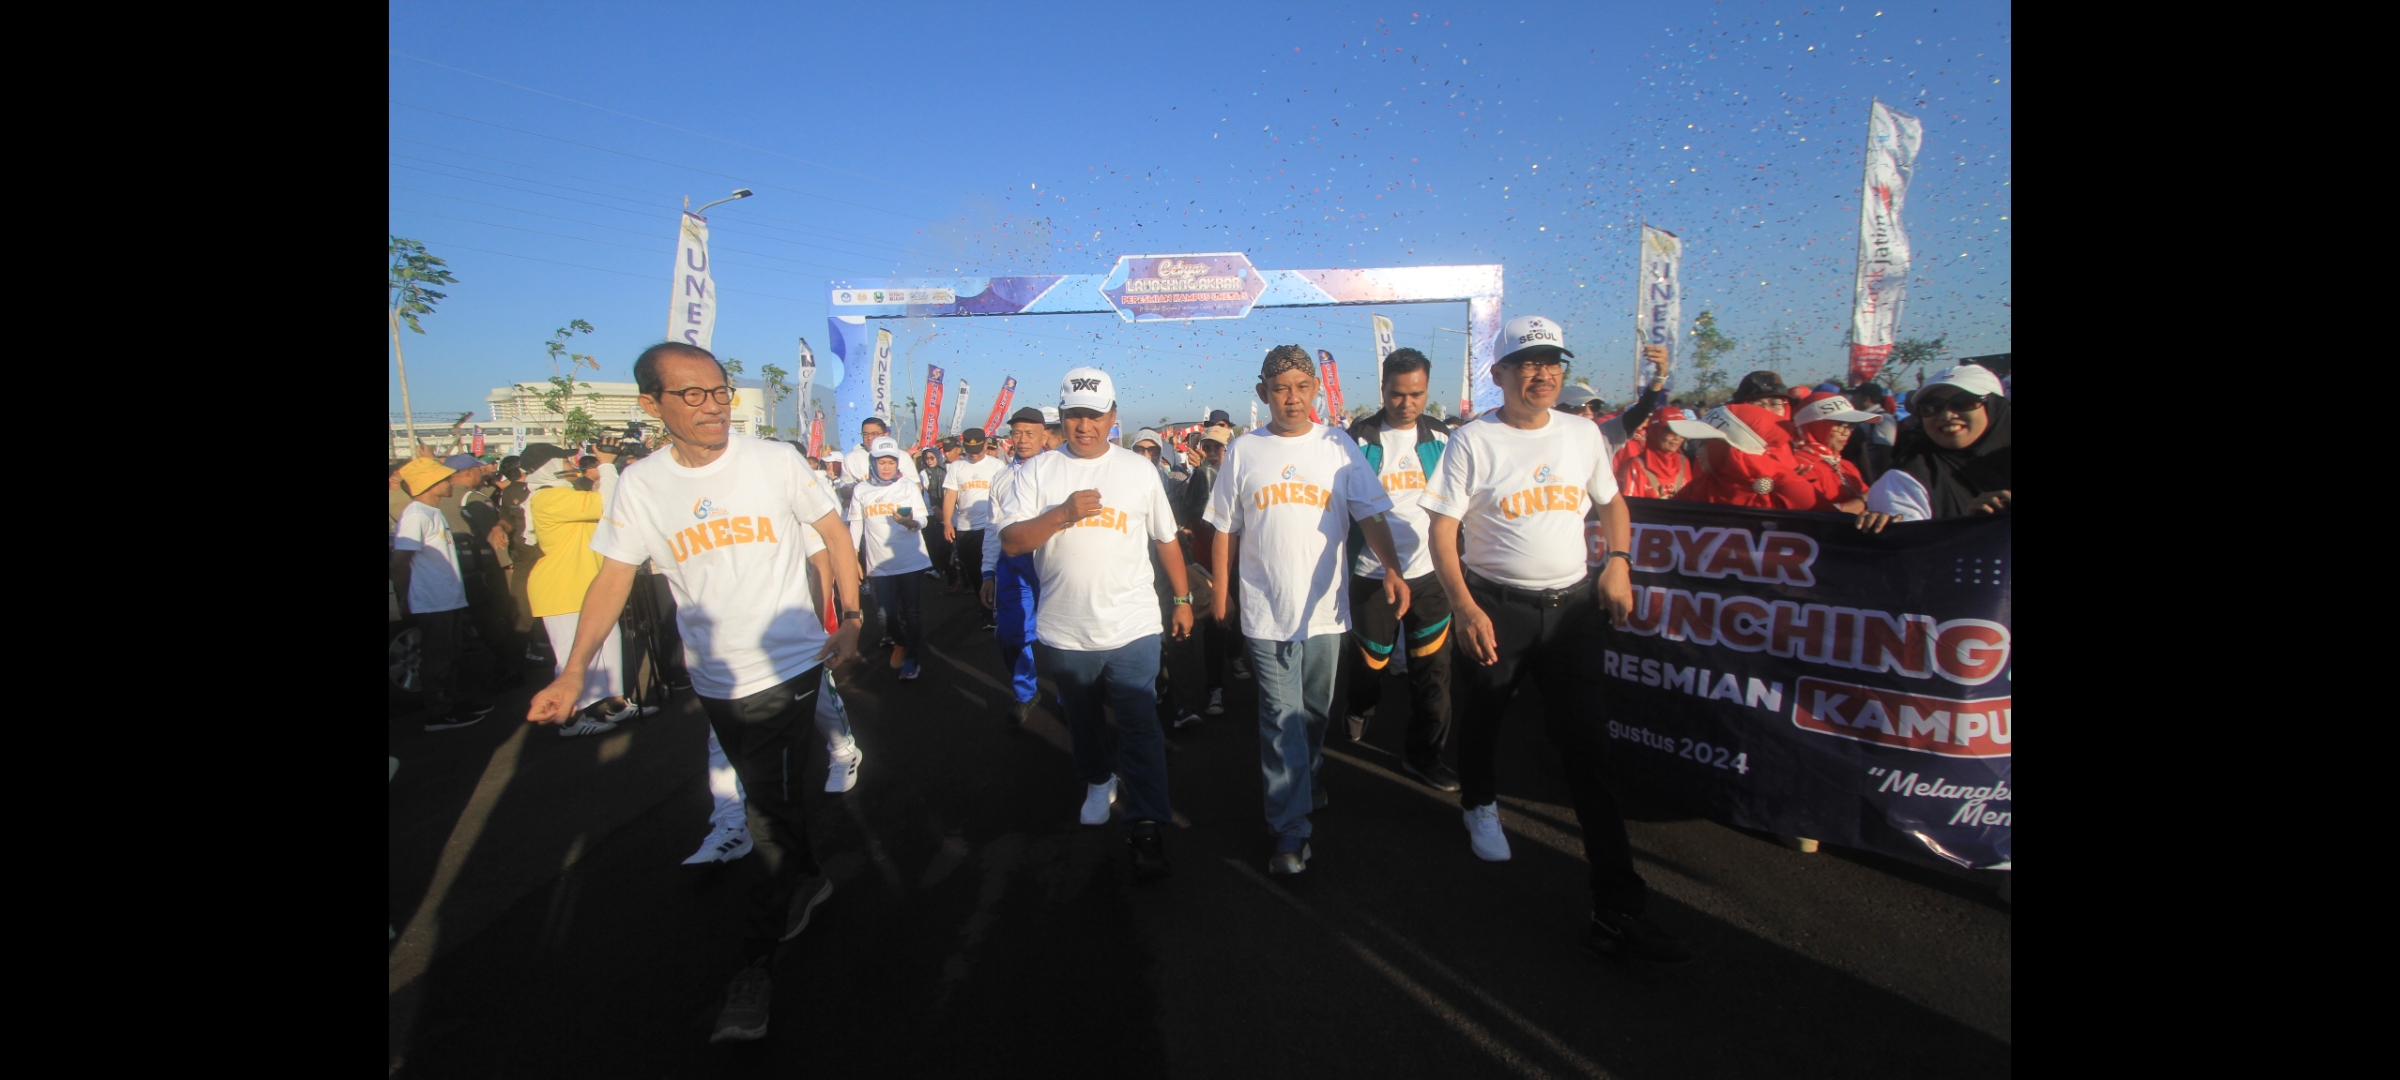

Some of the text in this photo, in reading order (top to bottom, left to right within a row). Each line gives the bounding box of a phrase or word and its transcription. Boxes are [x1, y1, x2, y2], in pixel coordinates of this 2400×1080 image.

[1122, 293, 1172, 304] PERESMIAN
[1173, 293, 1210, 303] KAMPUS
[1211, 291, 1241, 301] UNESA
[1126, 277, 1198, 293] LAUNCHING
[1519, 332, 1557, 344] SEOUL
[875, 347, 889, 413] UNESA
[1070, 378, 1101, 393] PXG
[1254, 482, 1332, 513] UNESA
[667, 516, 778, 563] UNESA
[1584, 521, 1818, 587] GBYAR
[1609, 586, 2011, 686] UNCHING
[1604, 649, 1783, 713] RESMIAN
[1679, 737, 1749, 775] 2024
